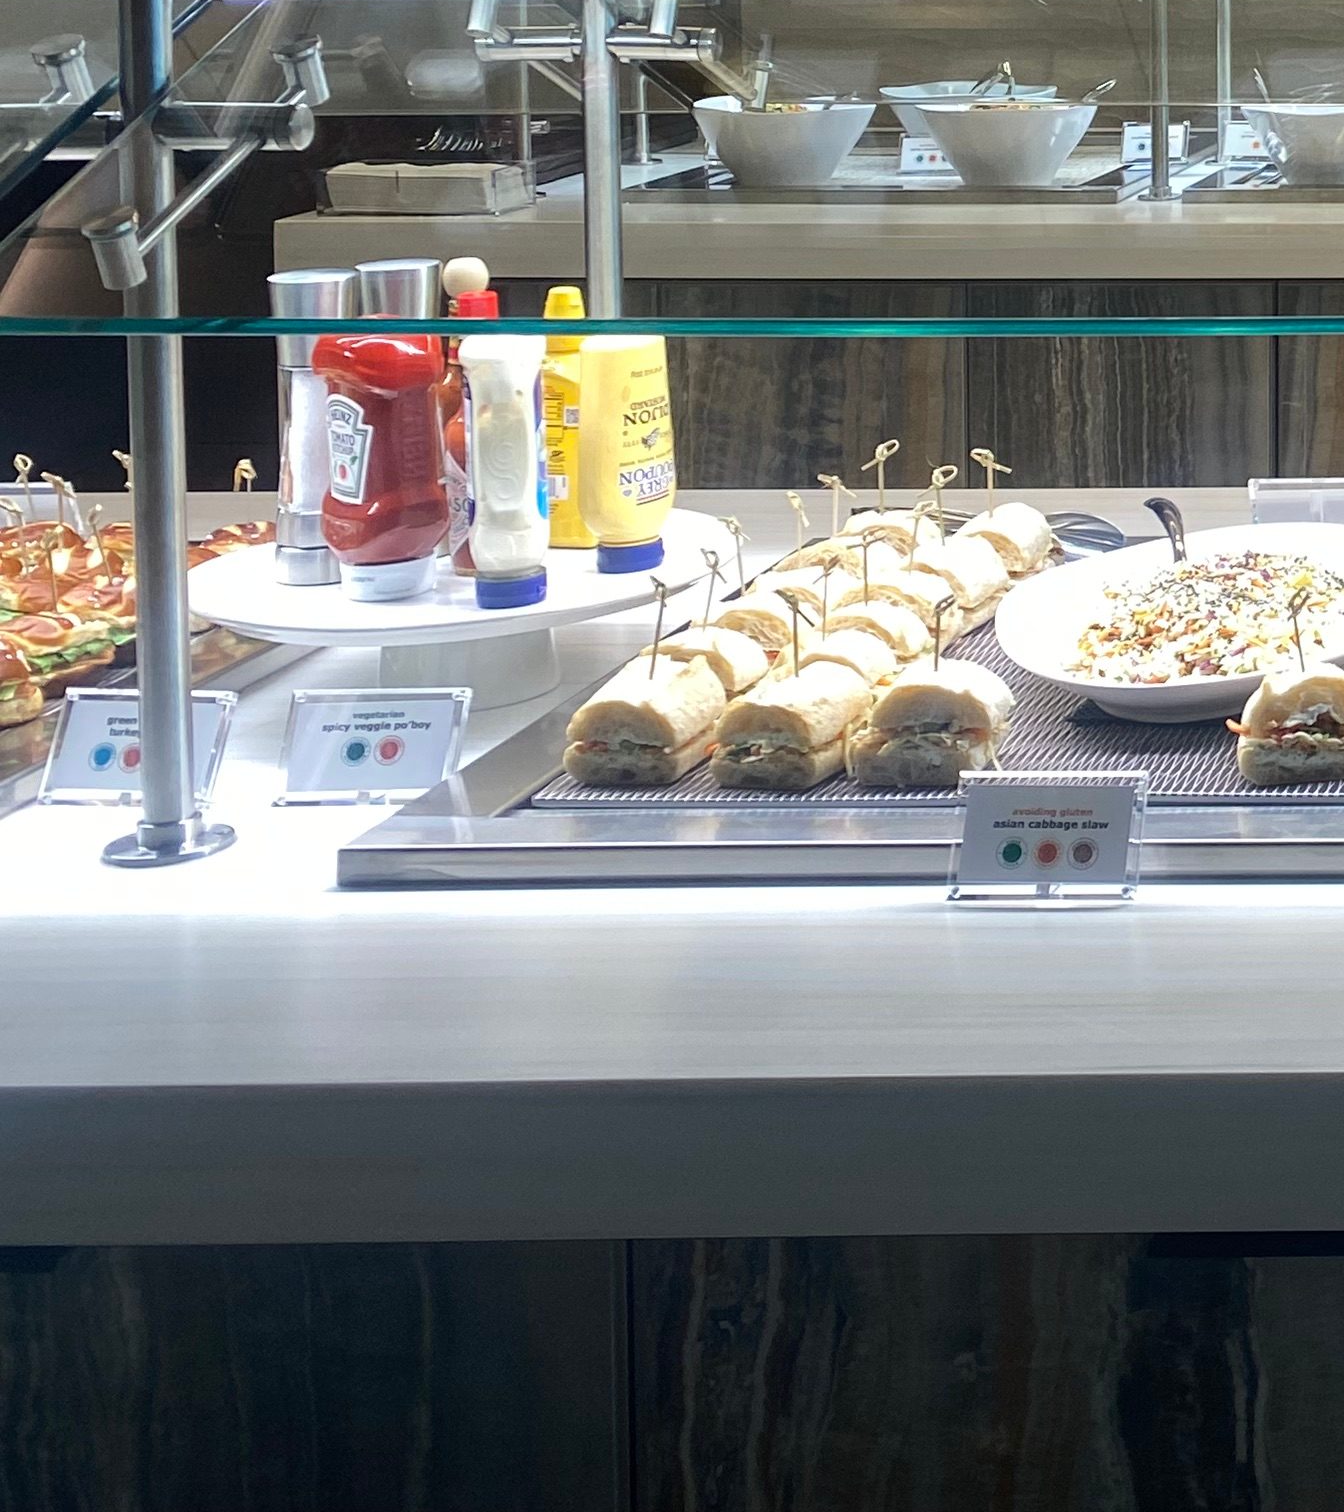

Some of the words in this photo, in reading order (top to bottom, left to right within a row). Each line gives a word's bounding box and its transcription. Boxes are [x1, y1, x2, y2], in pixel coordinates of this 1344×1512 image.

[637, 476, 669, 497] GREY
[352, 711, 405, 720] vegetarian
[107, 717, 137, 726] green
[322, 722, 351, 732] spicy
[354, 721, 391, 732] veggie
[1012, 808, 1057, 817] avoiding
[1059, 808, 1093, 817] gluten
[993, 819, 1025, 829] asian
[1028, 819, 1078, 831] cabbage
[1081, 820, 1109, 829] slaw
